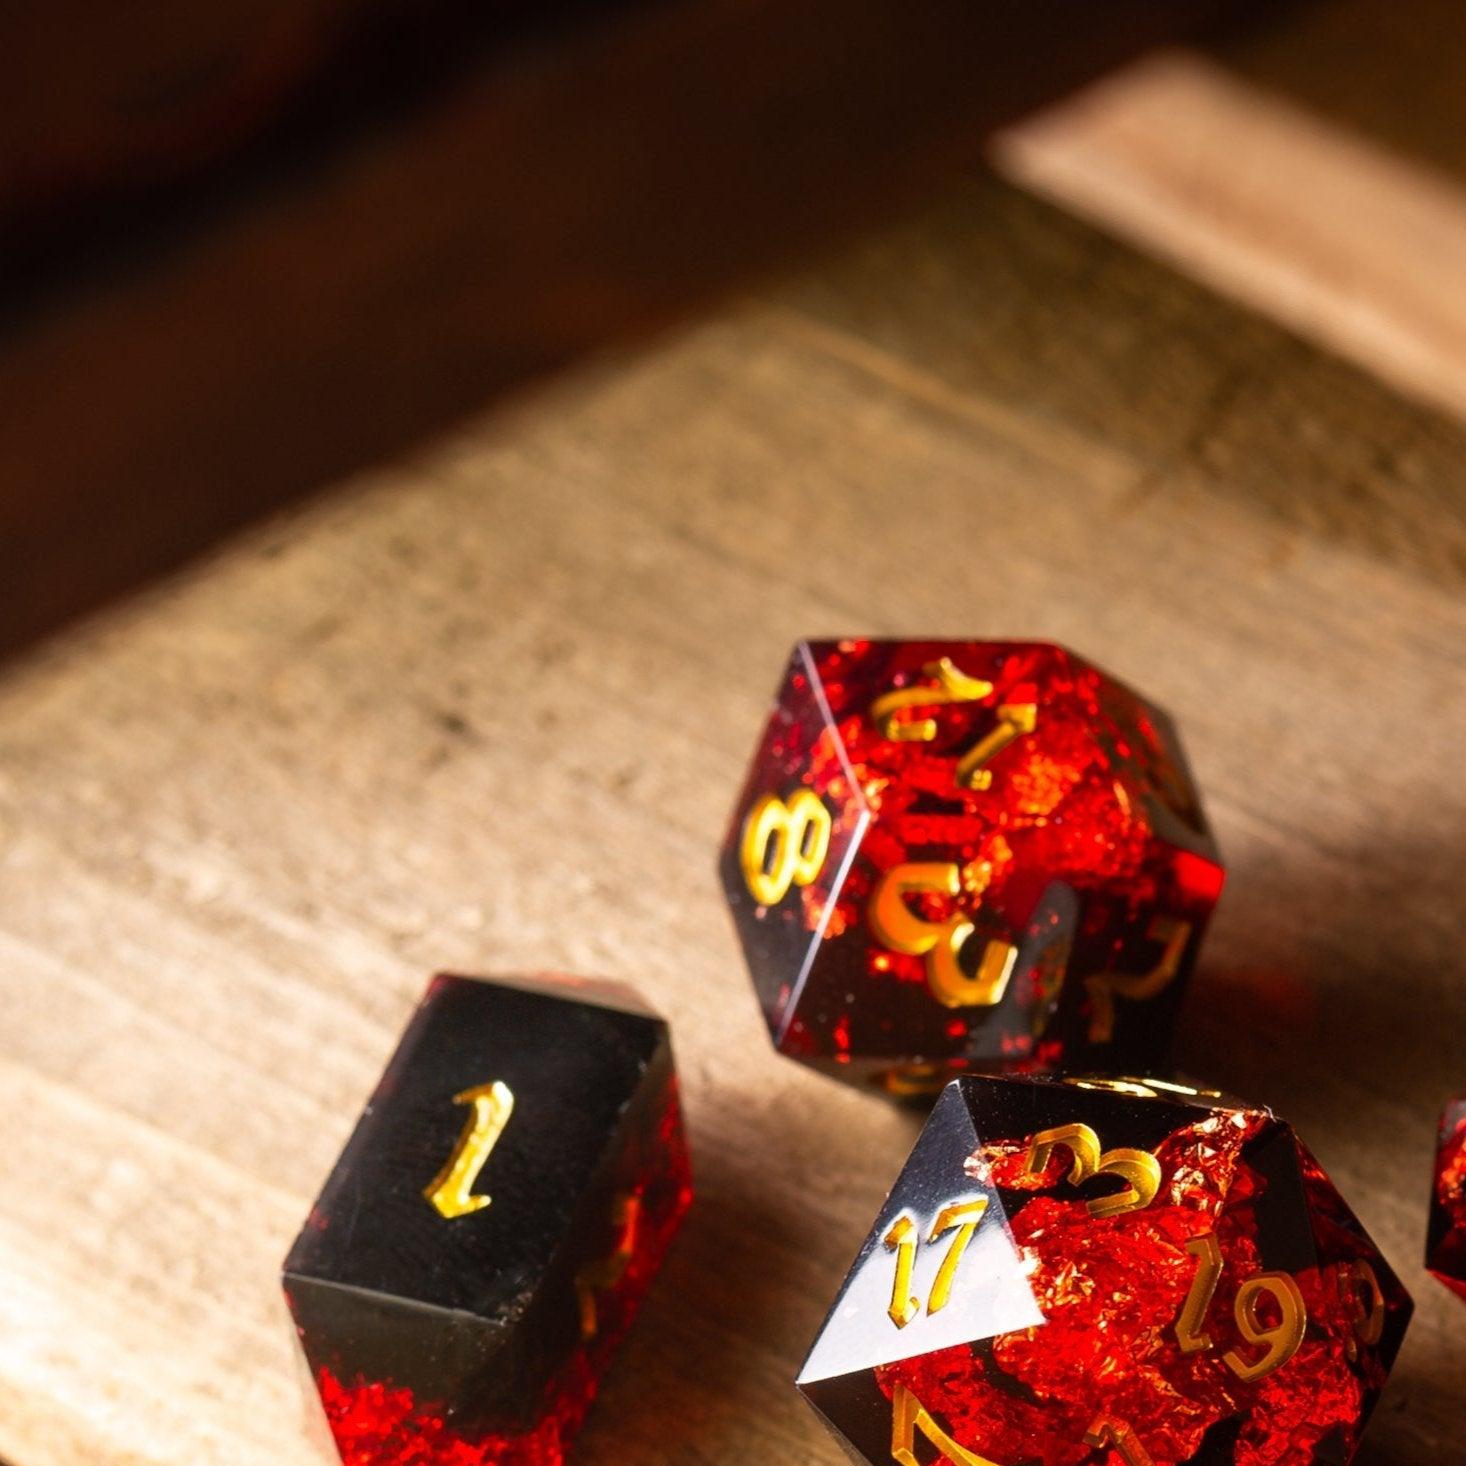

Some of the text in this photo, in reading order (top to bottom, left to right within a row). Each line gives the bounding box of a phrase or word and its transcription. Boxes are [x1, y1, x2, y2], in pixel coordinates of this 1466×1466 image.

[870, 657, 1037, 790] 12
[740, 788, 831, 905] 8
[872, 862, 1018, 1008] 3
[422, 1081, 514, 1219] 1
[1026, 1121, 1163, 1220] 3
[883, 1192, 990, 1330] 17
[1173, 1233, 1308, 1385] 19
